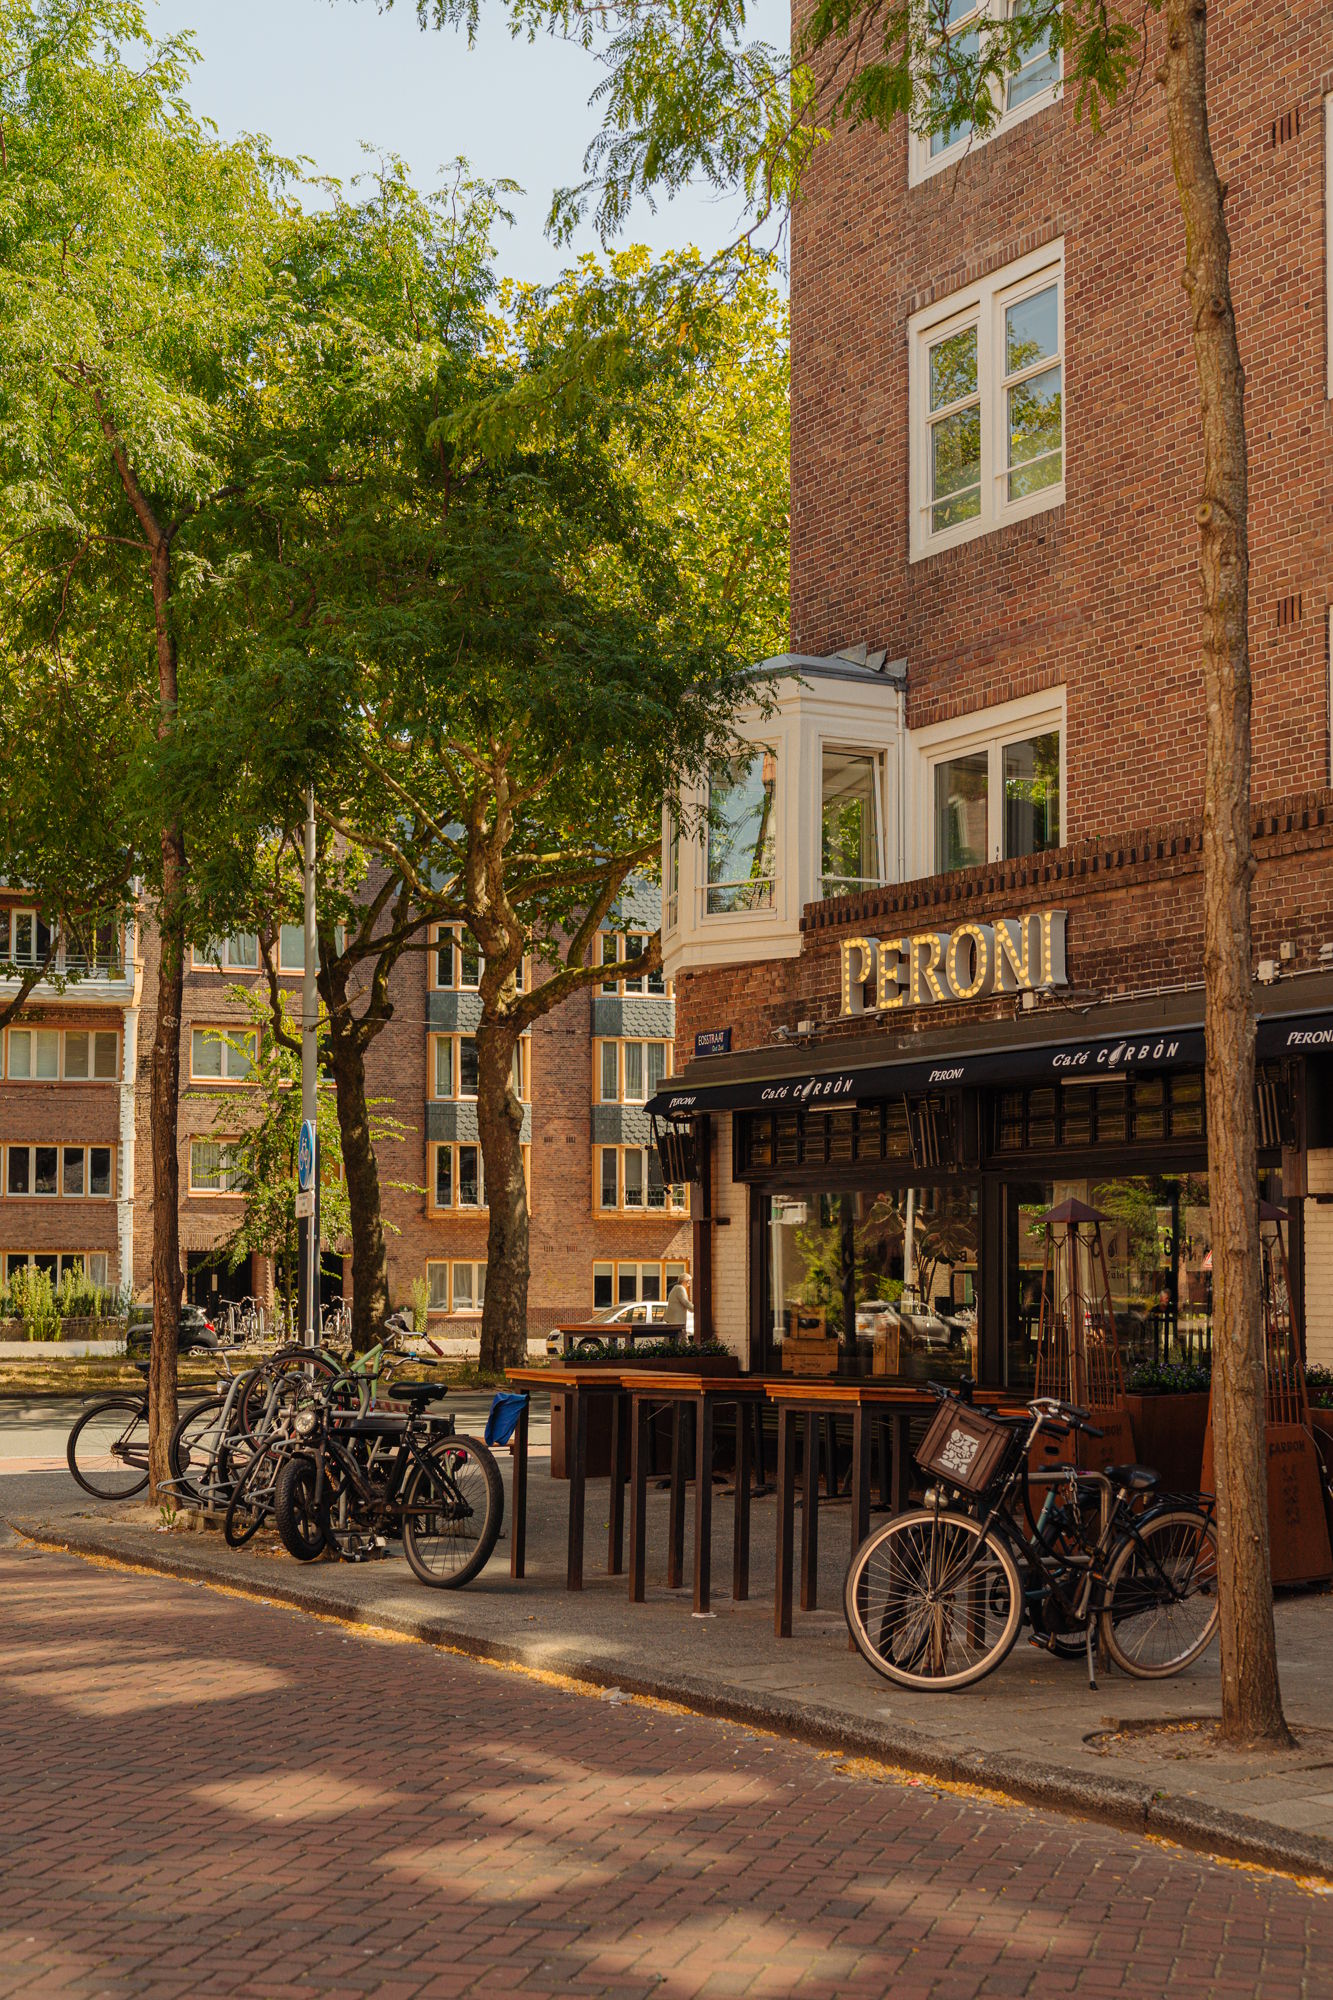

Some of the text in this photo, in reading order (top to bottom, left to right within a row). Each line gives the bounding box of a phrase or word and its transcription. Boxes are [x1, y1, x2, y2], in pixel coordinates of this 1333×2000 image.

[839, 910, 1068, 1016] PERONI
[698, 1032, 724, 1046] EOSSTRAAT
[1052, 1051, 1091, 1067] Café
[928, 1067, 964, 1082] PERONI
[761, 1086, 789, 1100] Café
[669, 1096, 696, 1108] PERONI
